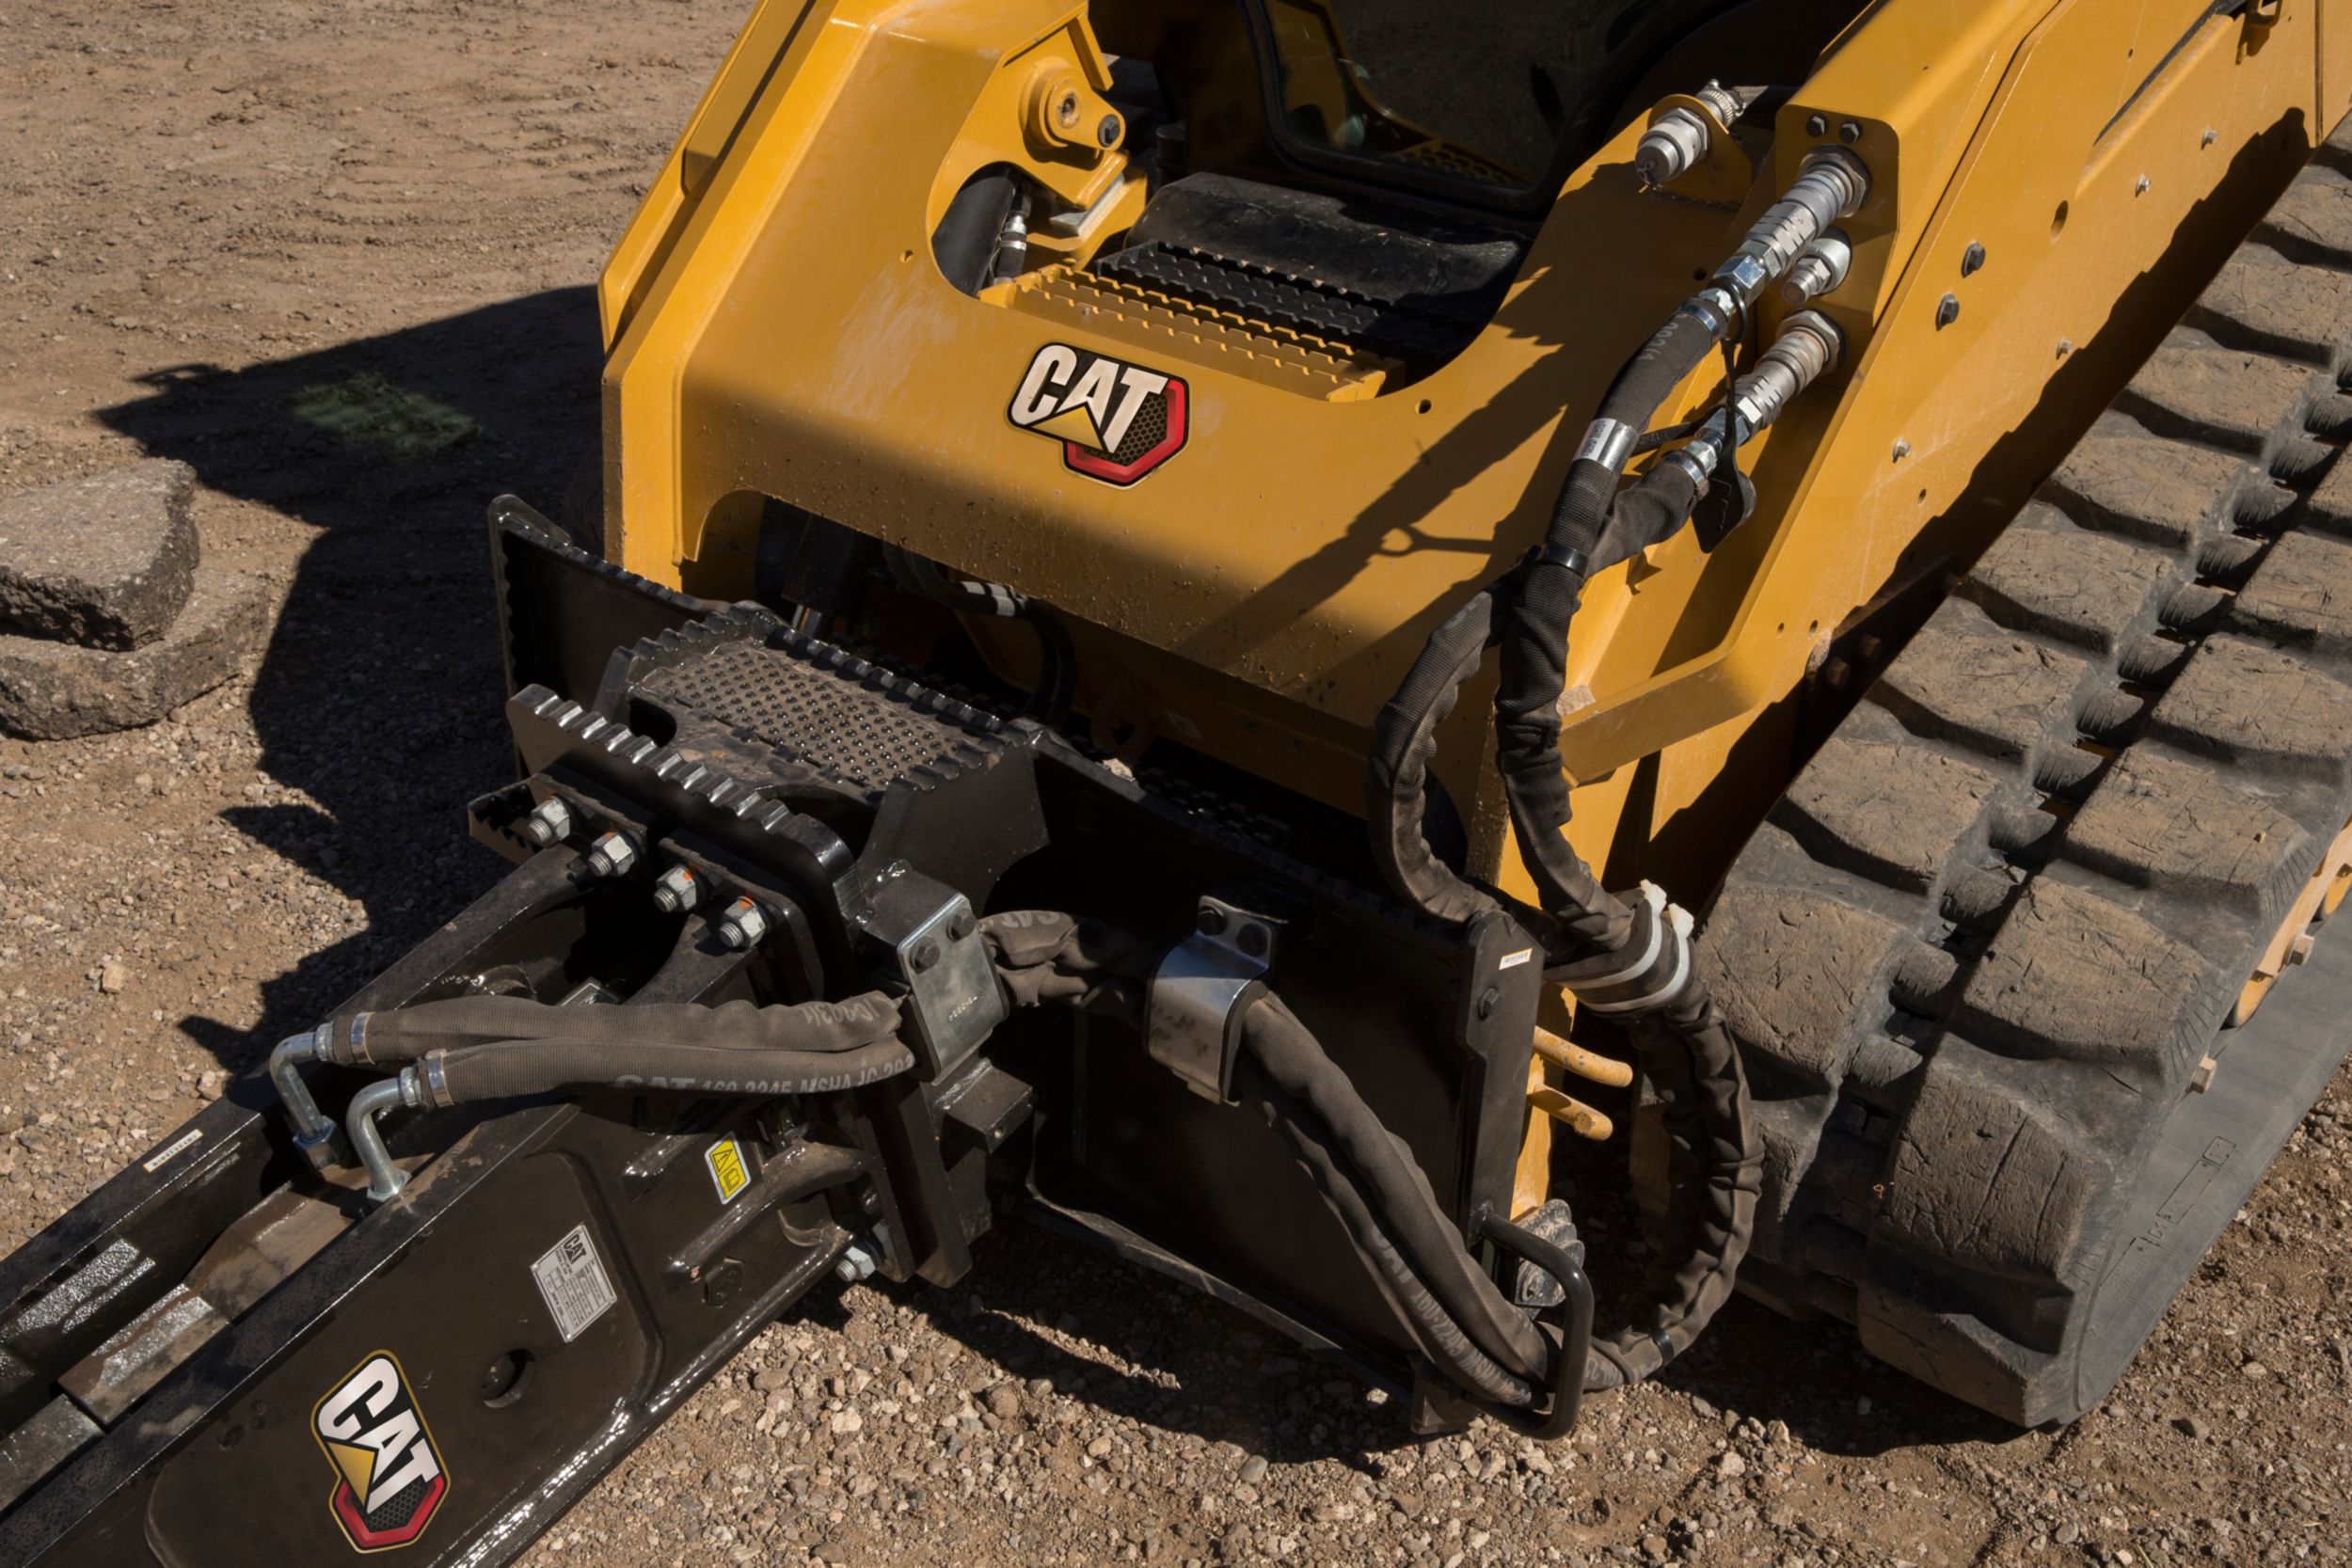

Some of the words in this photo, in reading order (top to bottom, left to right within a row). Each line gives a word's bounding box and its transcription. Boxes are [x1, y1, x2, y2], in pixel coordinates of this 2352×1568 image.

[1010, 344, 1169, 454] CAT
[564, 1233, 587, 1264] CAT
[318, 1357, 440, 1514] CAT
